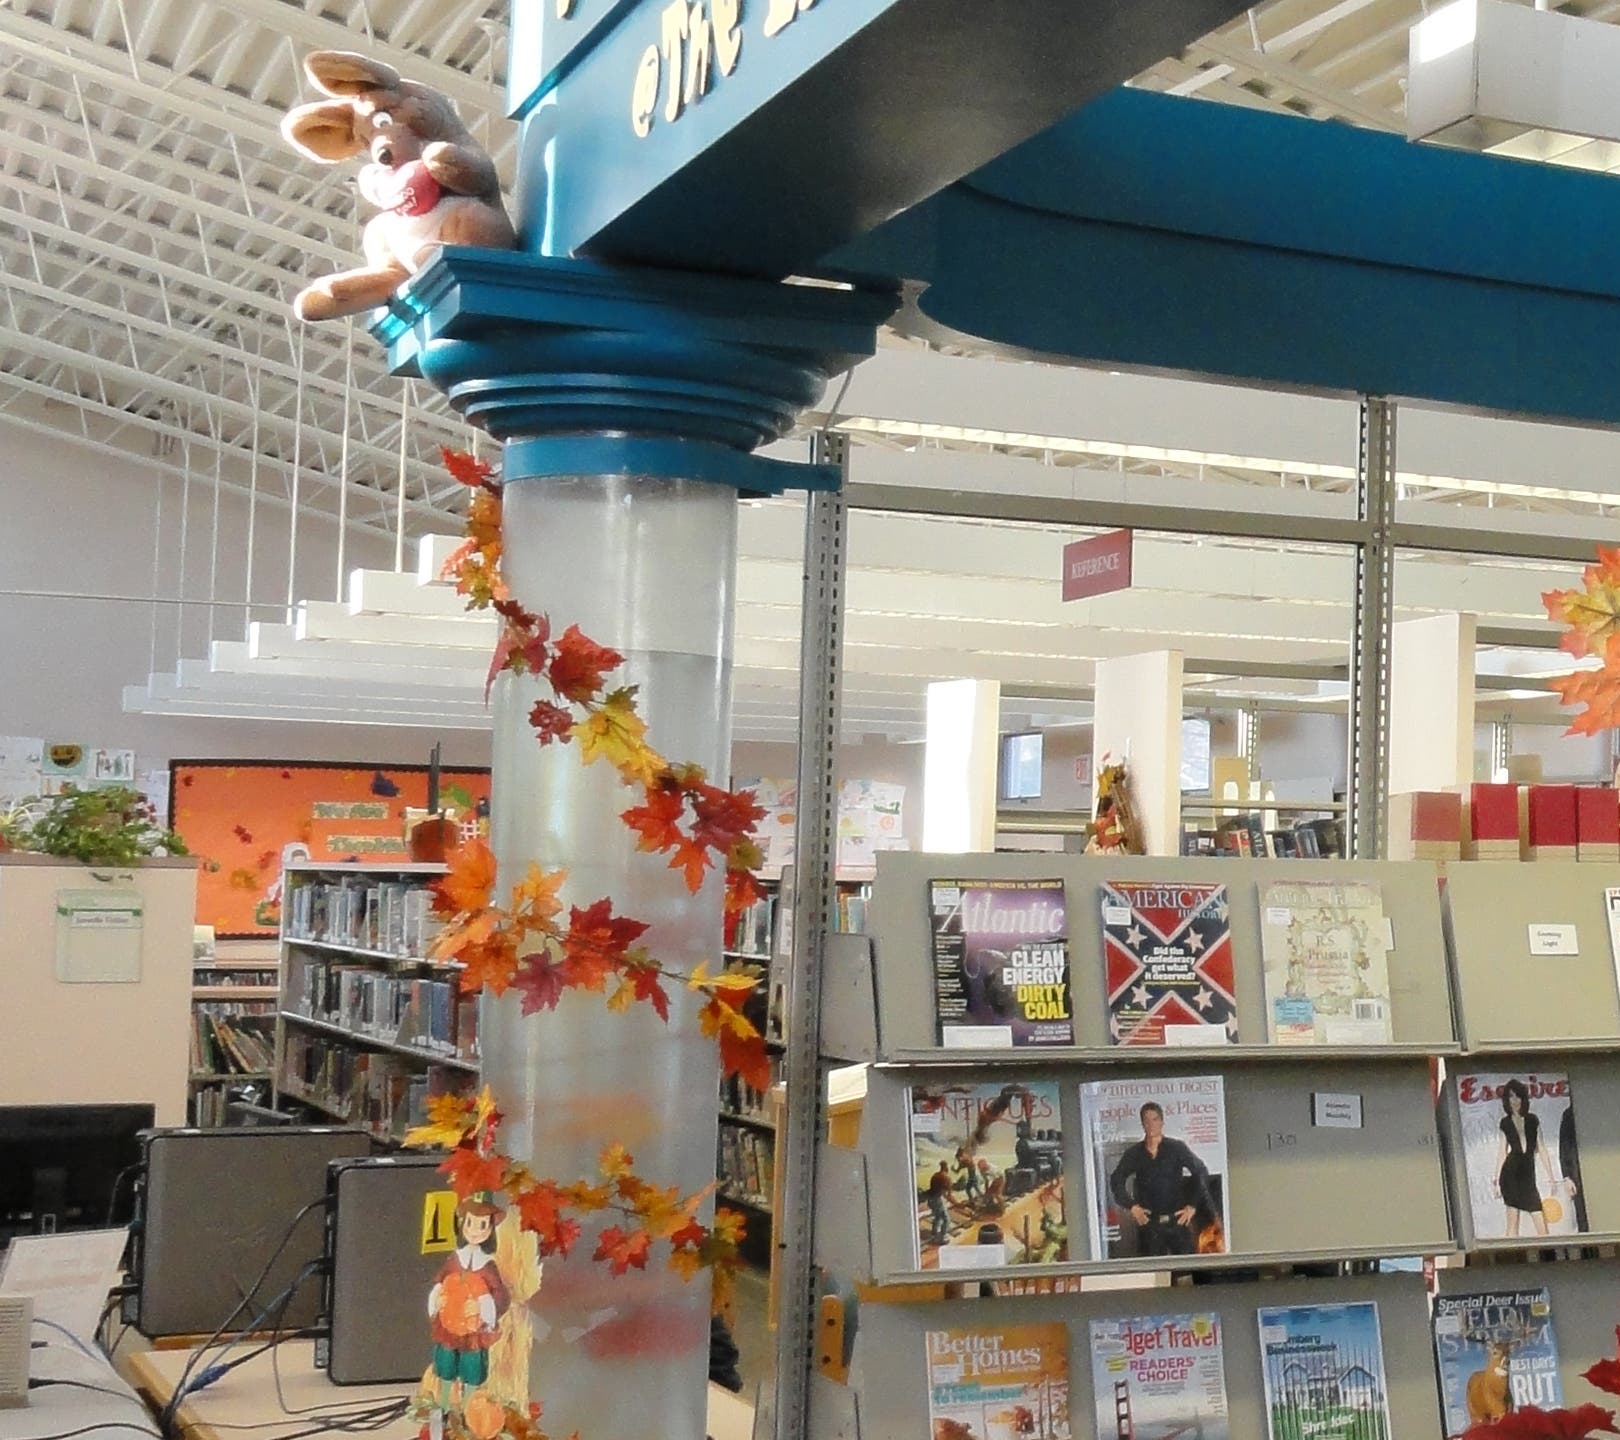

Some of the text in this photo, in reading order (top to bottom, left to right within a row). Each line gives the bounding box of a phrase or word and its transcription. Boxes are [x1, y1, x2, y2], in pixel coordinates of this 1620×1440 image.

[936, 891, 1065, 933] Atlantic
[1012, 950, 1065, 968] CLEAN
[1142, 955, 1196, 966] Confederacy
[1153, 946, 1185, 956] Did the
[1002, 967, 1065, 986] ENERGY
[1151, 963, 1189, 974] get what
[1016, 983, 1067, 1003] DIRTY
[1024, 1001, 1070, 1020] COAL
[1176, 1101, 1218, 1115] Places
[1438, 1292, 1545, 1311] Special Deer Issue
[932, 1330, 1004, 1355] Better
[1164, 1321, 1219, 1349] Travel
[954, 1347, 1042, 1377] Homes
[1137, 1368, 1189, 1383] CHOICE
[1511, 1371, 1557, 1415] RUT
